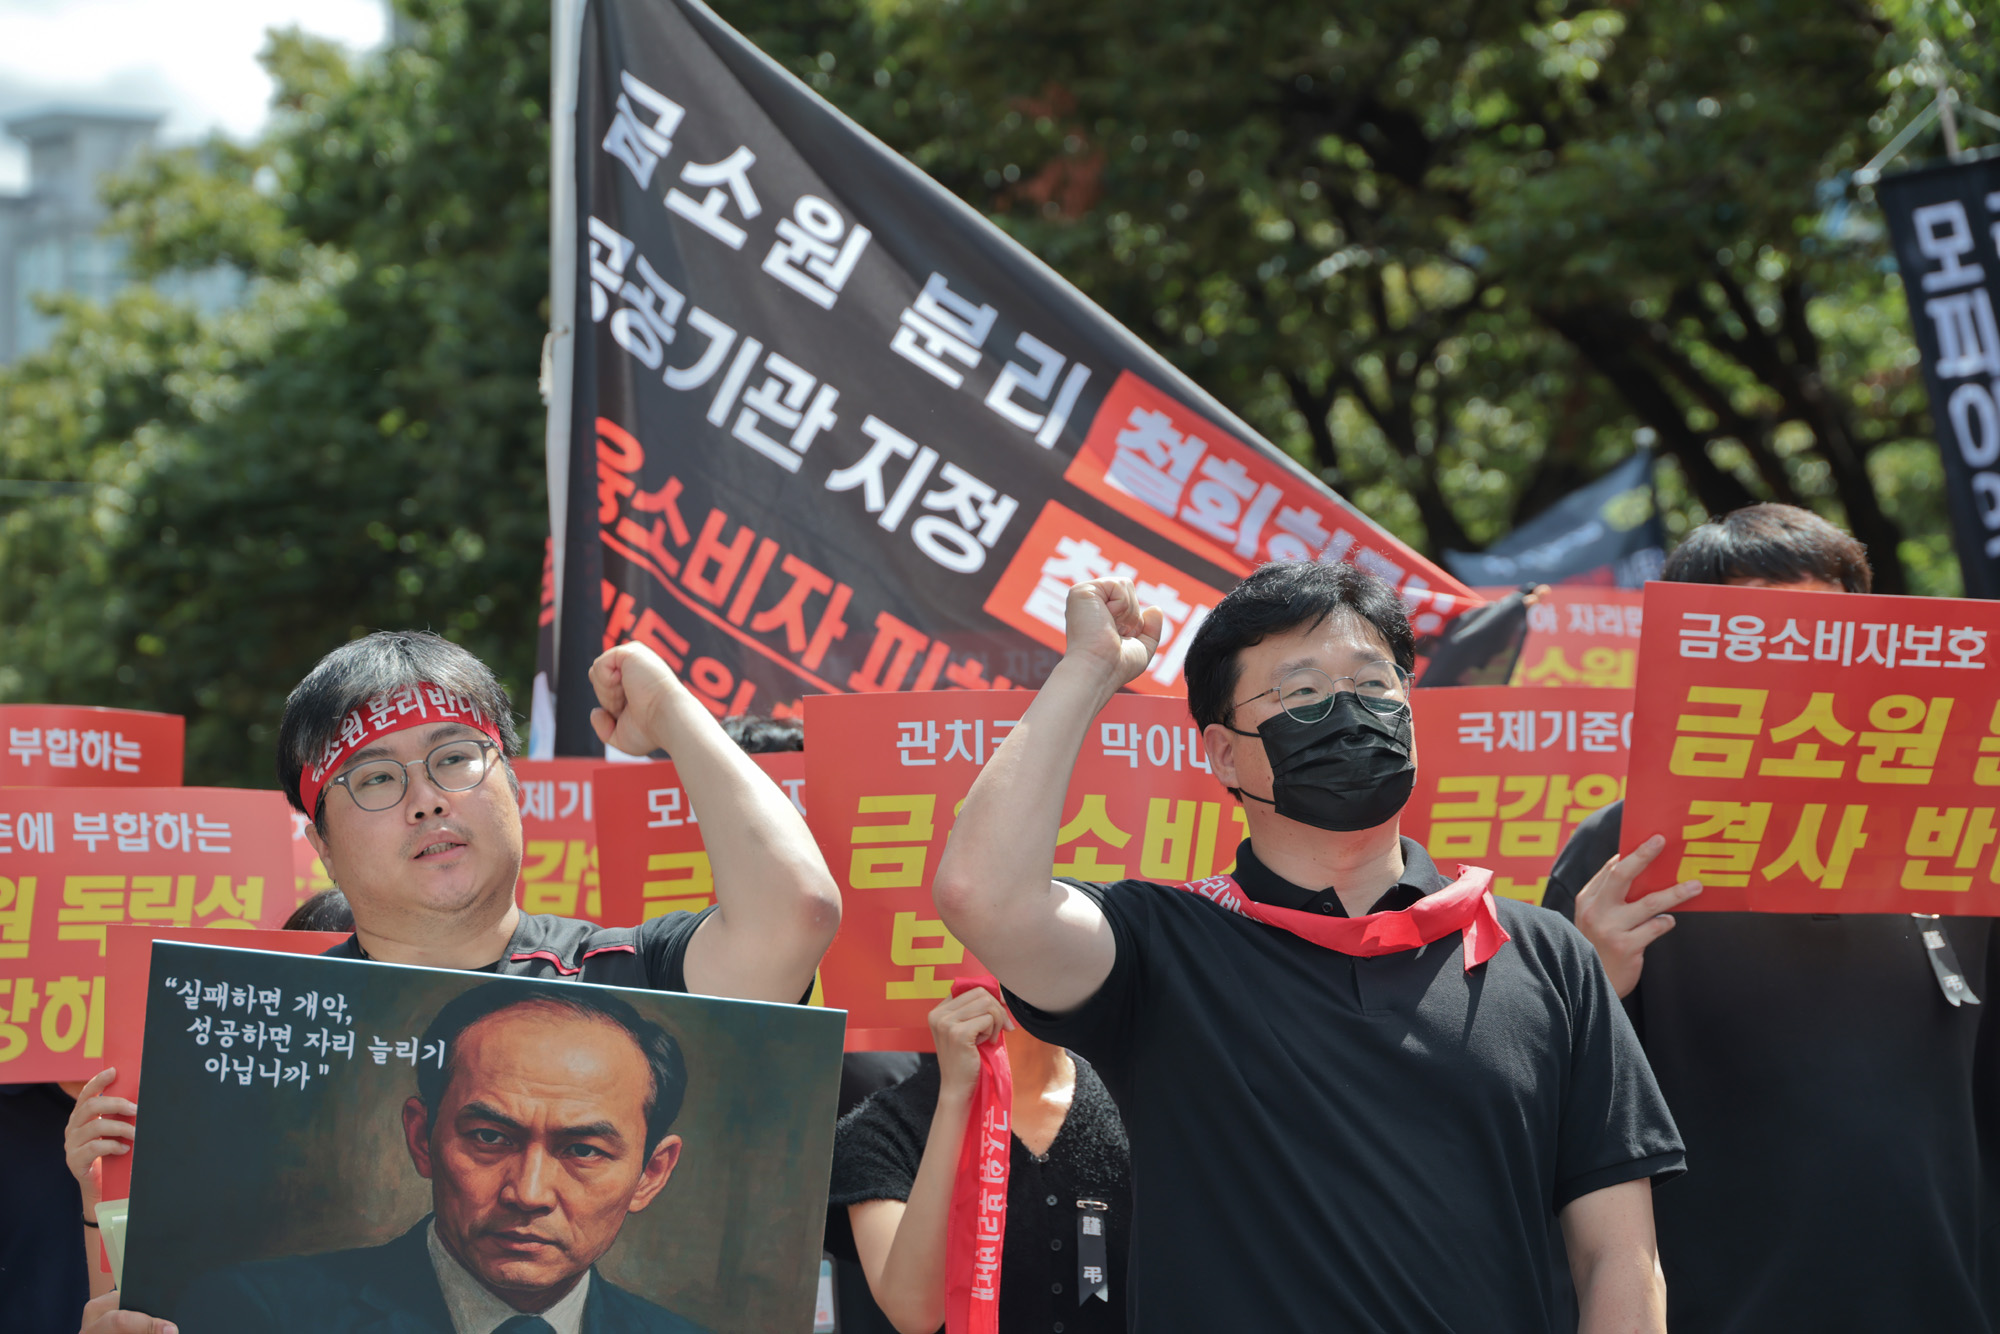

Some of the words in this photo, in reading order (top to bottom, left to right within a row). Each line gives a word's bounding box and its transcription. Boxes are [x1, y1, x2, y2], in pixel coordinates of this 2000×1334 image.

[890, 271, 1092, 449] 분리
[825, 415, 1019, 573] 지정
[1679, 612, 1988, 669] 금융소비자보호
[8, 727, 142, 774] 부합하는
[1458, 710, 1634, 752] 국제기준
[1669, 685, 1955, 785] 금소원
[73, 812, 232, 854] 부합하는
[1676, 800, 1869, 889] 결사
[1900, 806, 2000, 892] 반
[294, 991, 353, 1025] 개악,
[187, 1015, 292, 1053] 성공하면
[304, 1028, 355, 1060] 자리
[368, 1035, 446, 1069] 늘리기
